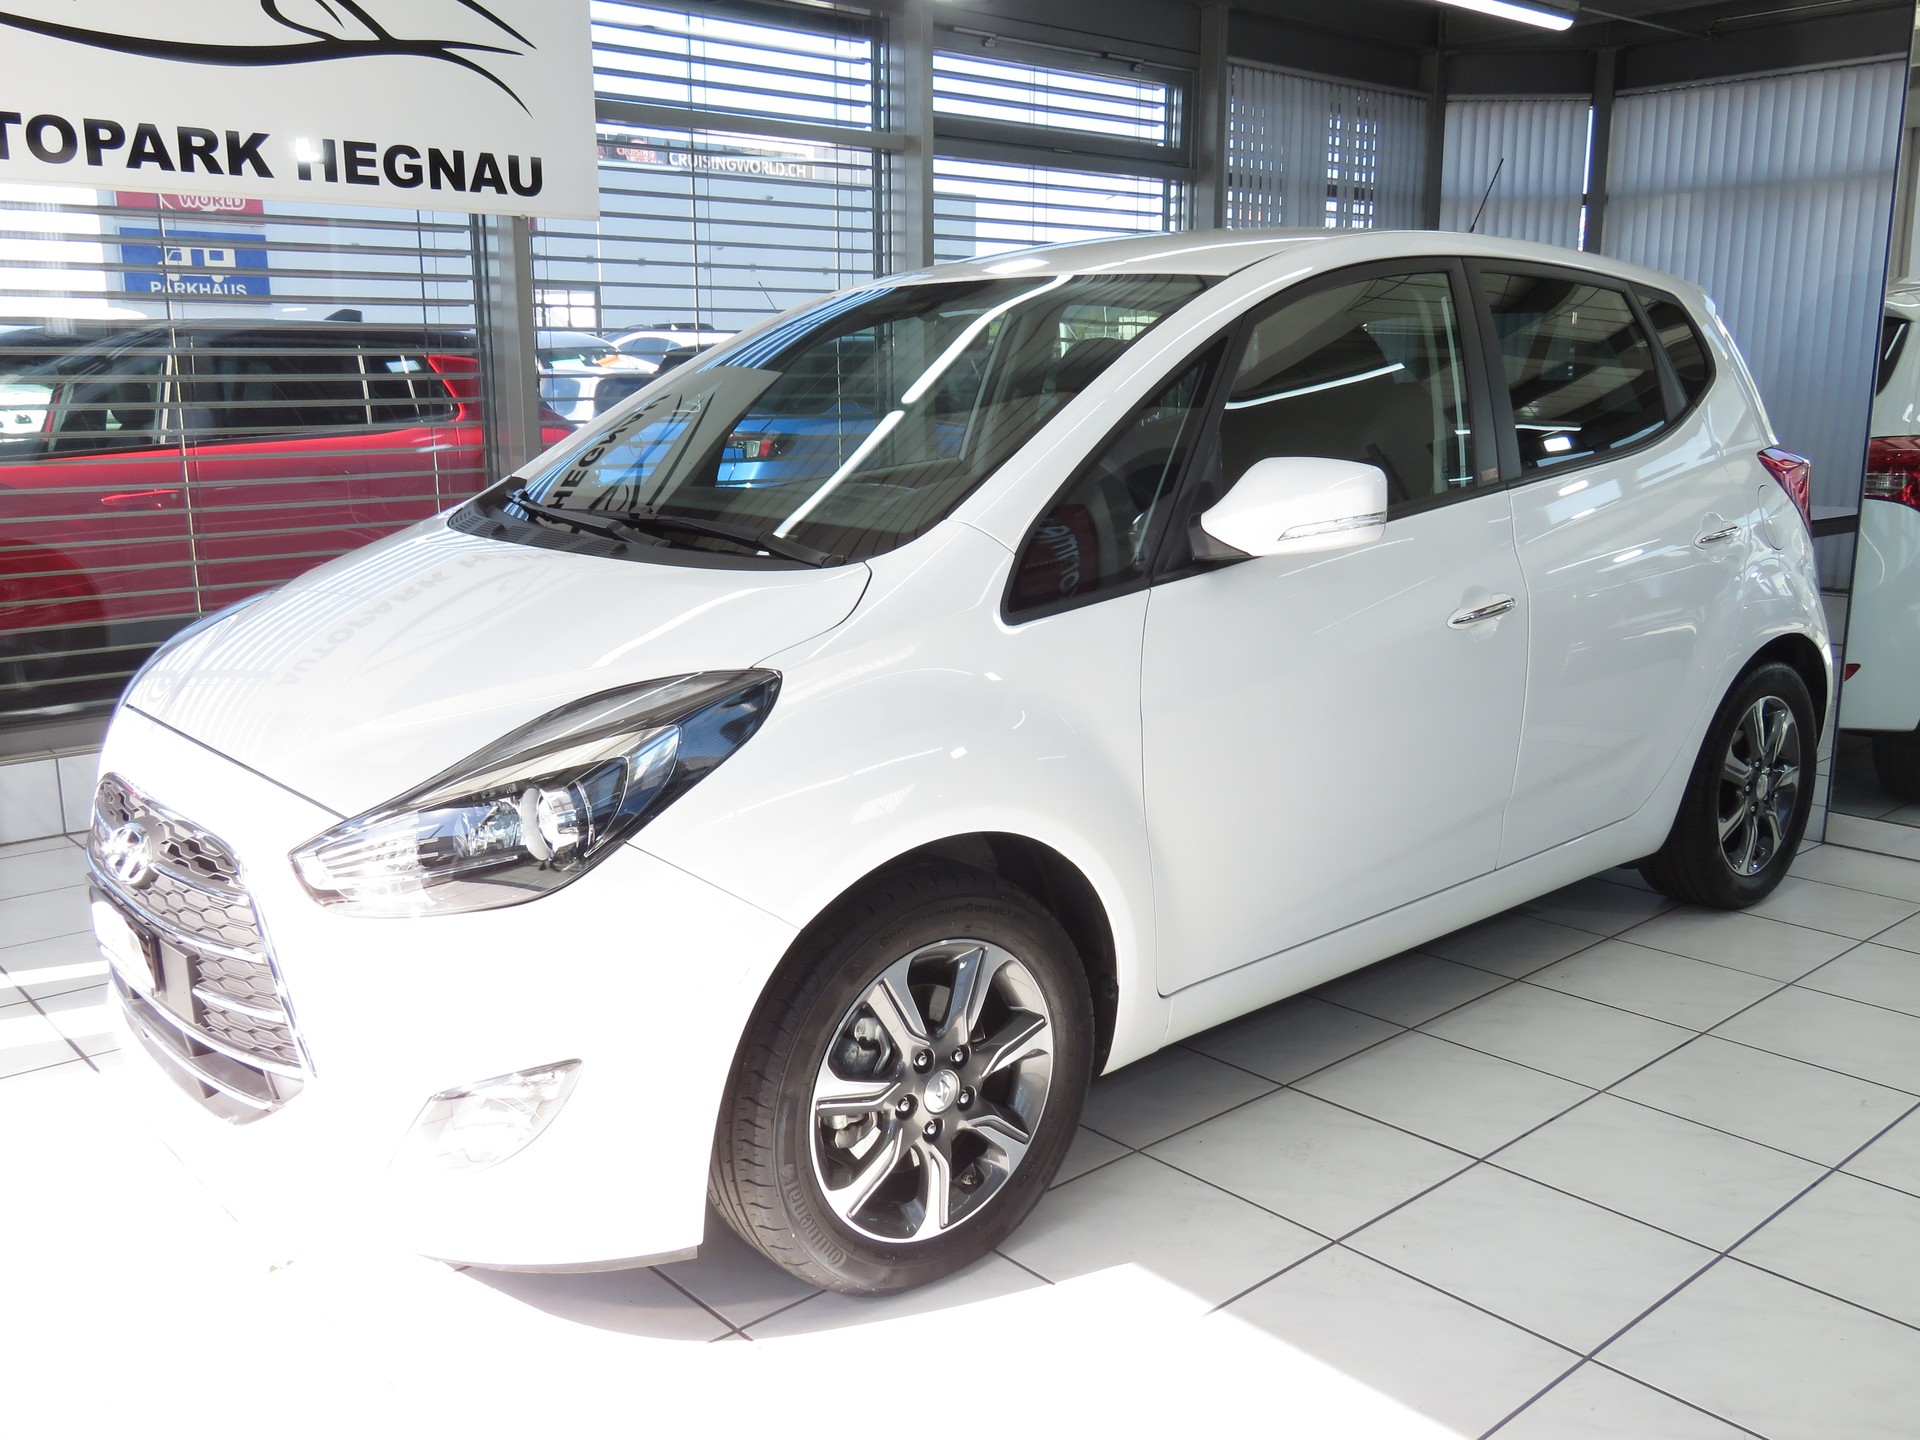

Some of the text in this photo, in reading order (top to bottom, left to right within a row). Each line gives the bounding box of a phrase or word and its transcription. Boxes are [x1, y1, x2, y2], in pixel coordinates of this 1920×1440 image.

[296, 132, 543, 197] HEGNAU
[669, 152, 806, 178] CRUISINGWORLD.CH
[150, 281, 247, 295] PARKHAUS
